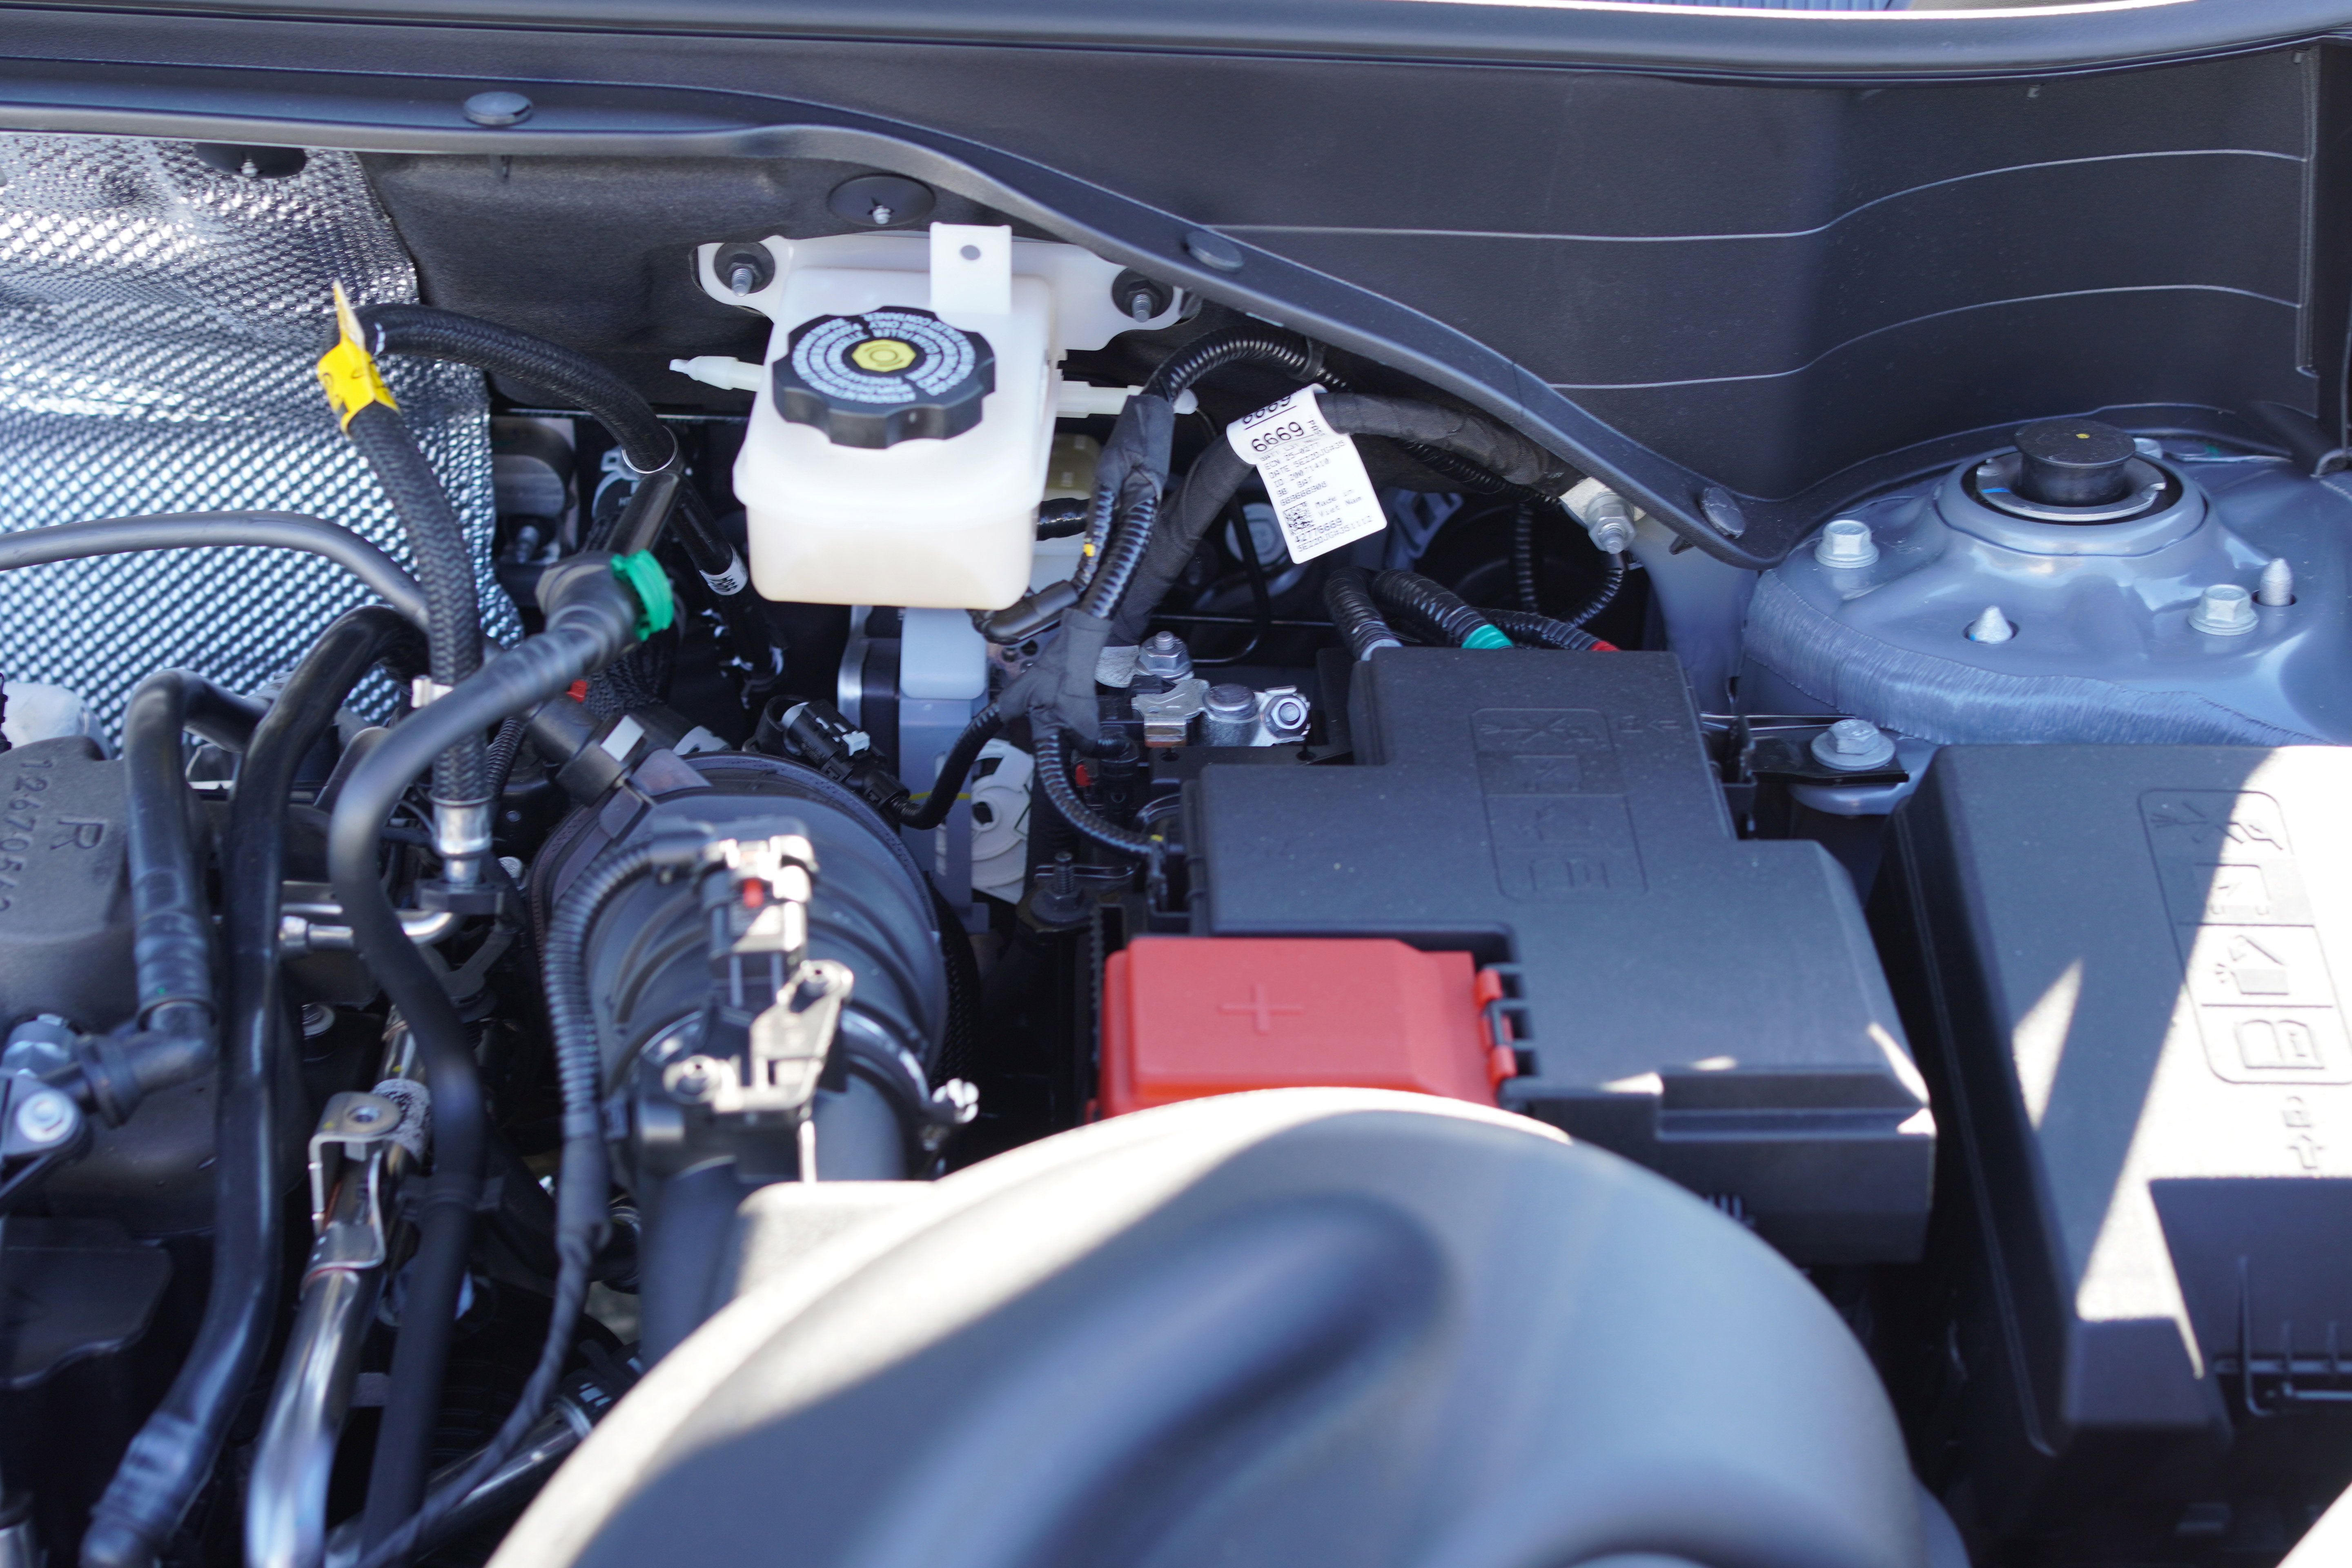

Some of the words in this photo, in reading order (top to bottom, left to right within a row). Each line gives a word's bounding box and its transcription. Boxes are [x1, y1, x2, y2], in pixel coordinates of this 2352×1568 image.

[1252, 421, 1304, 452] 6669
[1264, 459, 1281, 470] ECN
[1269, 465, 1290, 479] DATE
[1274, 479, 1284, 488] ID
[1297, 477, 1313, 488] BAT
[1315, 496, 1337, 508] Made
[1319, 505, 1340, 517] Viet
[1345, 495, 1362, 506] Nam
[49, 817, 106, 851] R
